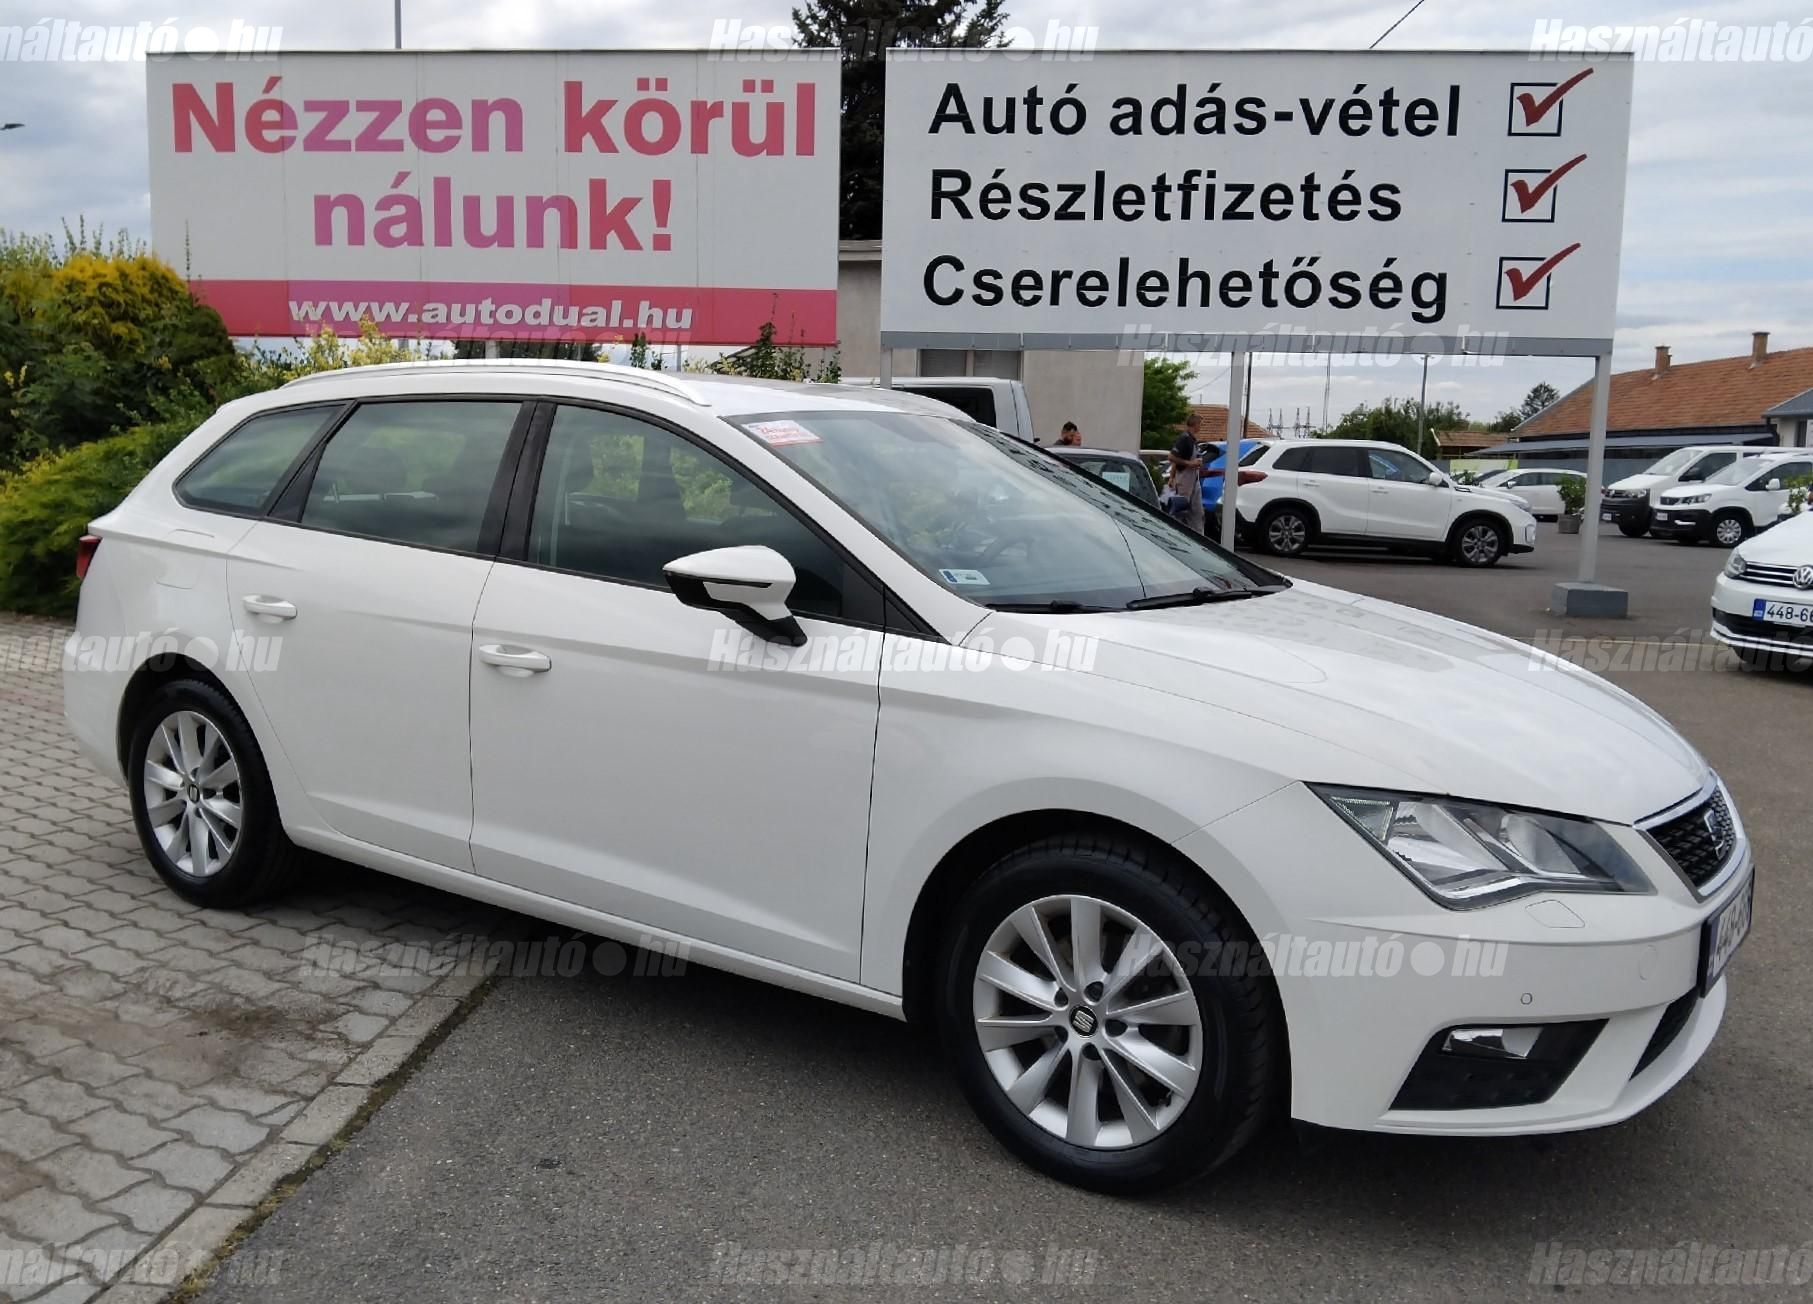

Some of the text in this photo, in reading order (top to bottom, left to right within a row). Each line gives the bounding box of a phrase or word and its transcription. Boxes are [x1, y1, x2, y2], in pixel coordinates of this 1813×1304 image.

[173, 77, 815, 157] Nézzen körül
[924, 78, 1461, 137] Autó adás-vétel
[315, 172, 671, 251] nálunk!
[930, 169, 1402, 222] Részletfizetés
[289, 298, 693, 329] www.autodual.hu
[924, 255, 1448, 323] Cserelehetőség
